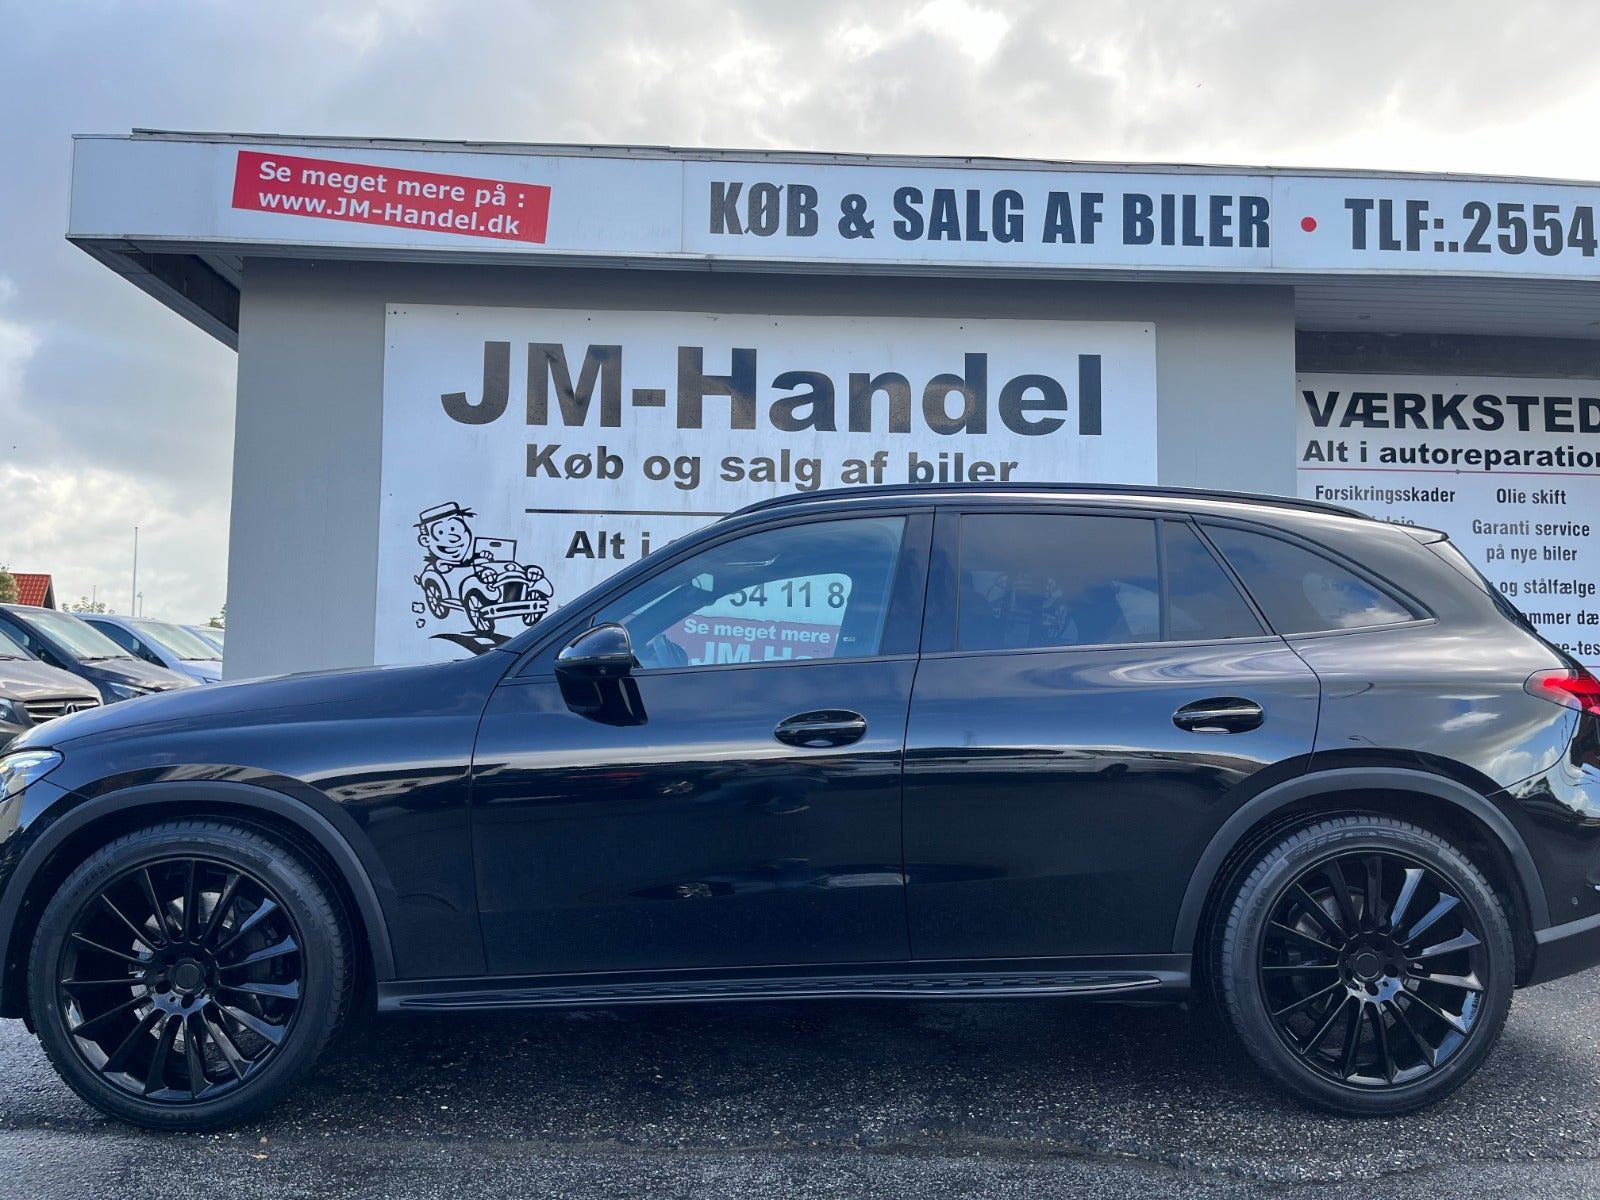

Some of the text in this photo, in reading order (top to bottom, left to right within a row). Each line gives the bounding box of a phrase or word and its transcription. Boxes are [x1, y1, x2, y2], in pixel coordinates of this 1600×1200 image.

[258, 161, 292, 183] Se
[301, 168, 388, 194] meget
[397, 180, 465, 202] mere
[475, 183, 506, 208] på
[258, 191, 520, 235] www.JM-Handel.dk
[709, 181, 1270, 248] KØB & SALG AF BILER
[441, 341, 1102, 436] JM-Handel
[1302, 390, 1600, 434] VÆRKSTED
[1303, 440, 1348, 462] Alt
[1360, 441, 1367, 463] i
[526, 444, 1019, 492] Køb og salg af biler
[1315, 485, 1456, 504] Forsikringsskader
[1496, 488, 1567, 505] Olie skift
[1472, 519, 1590, 537] Garanti service
[565, 531, 650, 559] Alt i
[1486, 544, 1578, 564] på nye biler
[1500, 577, 1596, 598] og stålfælge
[684, 618, 831, 644] Se meget mere
